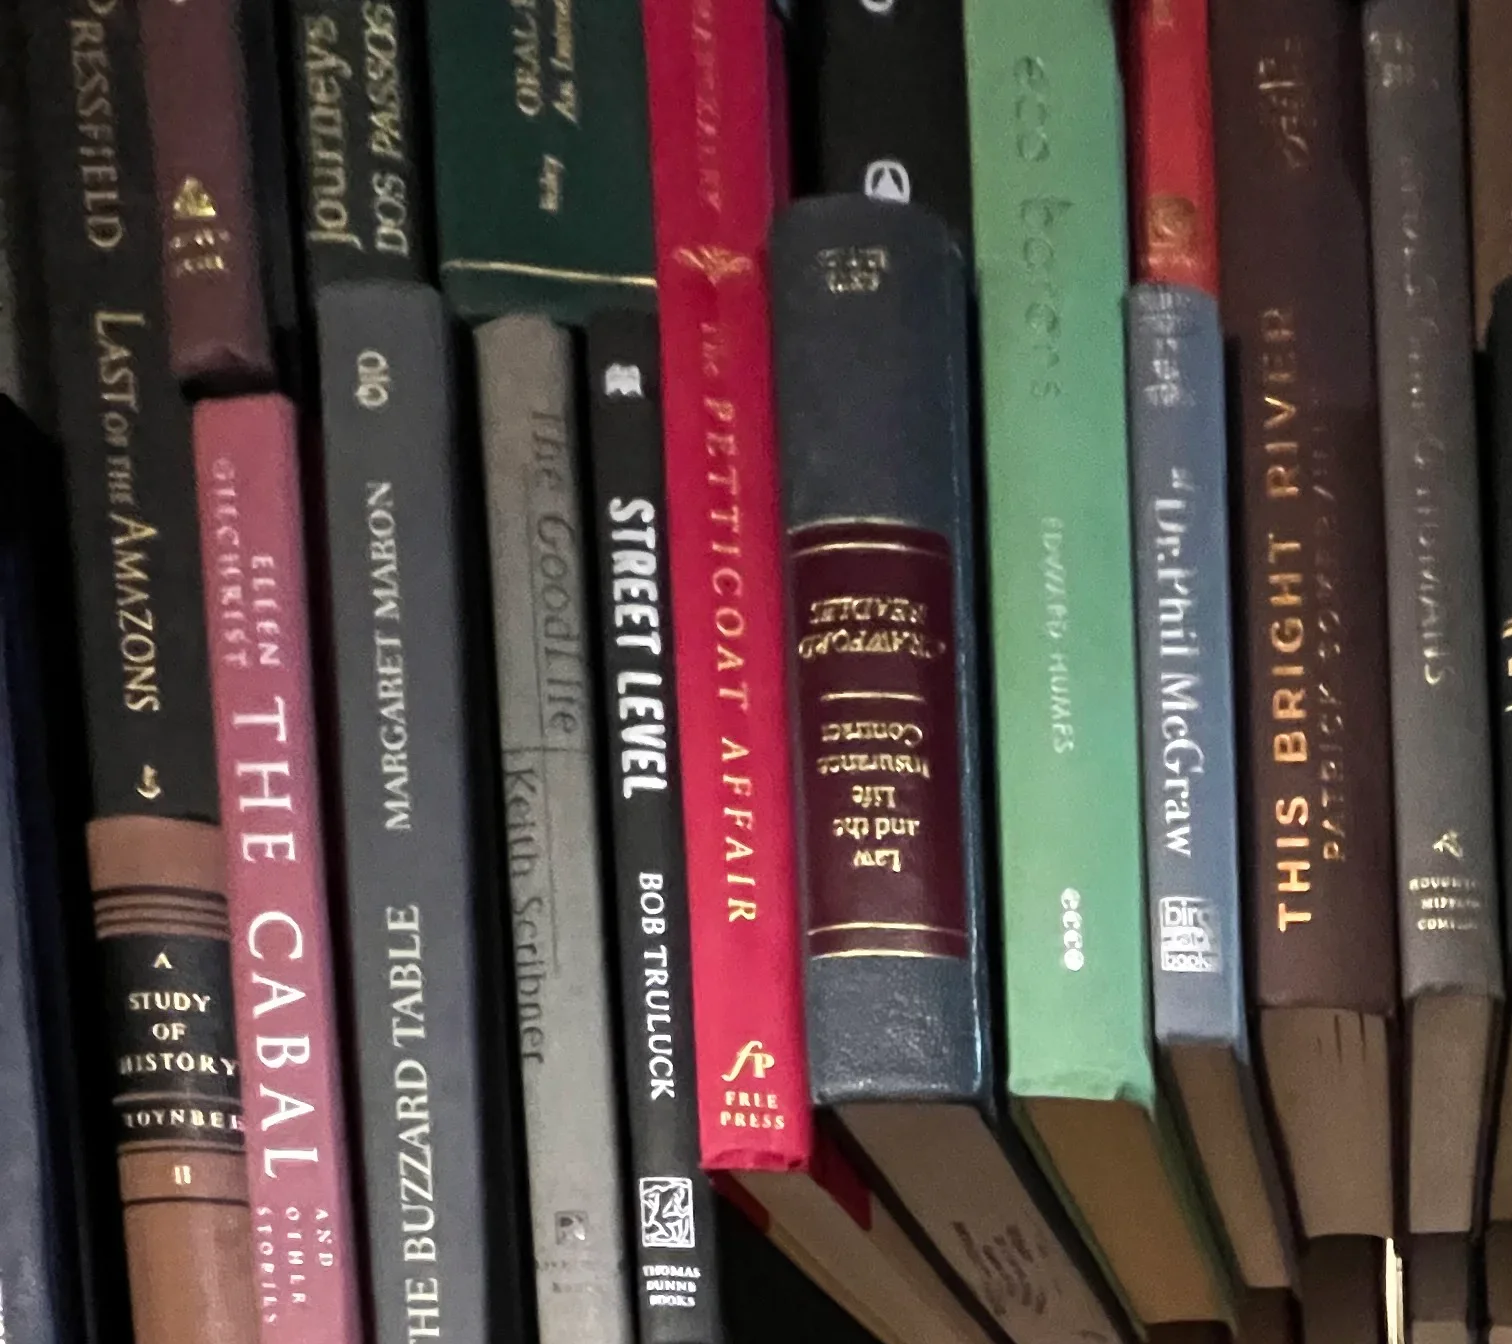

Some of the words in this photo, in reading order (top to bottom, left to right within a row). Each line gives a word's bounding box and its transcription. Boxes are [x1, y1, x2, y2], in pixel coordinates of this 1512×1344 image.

[303, 15, 363, 252] Journeys
[375, 173, 410, 258] DOS
[96, 310, 144, 408] LAST
[1263, 307, 1300, 499] RIVER
[110, 513, 162, 713] AMAZONS
[364, 480, 402, 616] MARON
[610, 497, 660, 657] STREET
[702, 397, 750, 716] PETTICOAT
[1266, 531, 1310, 761] BRIGHT
[231, 697, 296, 864] THE
[371, 629, 410, 832] MARGARET
[616, 671, 668, 799] LEVEL
[852, 785, 896, 808] Life
[1160, 668, 1204, 857] McGraw
[504, 767, 535, 882] Keith
[721, 736, 757, 925] AFFAIR
[853, 850, 901, 872] Law
[1275, 794, 1311, 932] THIS
[153, 951, 170, 970] A
[639, 872, 663, 935] BOB
[128, 991, 211, 1013] STUDY
[153, 1022, 186, 1041] OF
[385, 904, 420, 1041] TABLE
[512, 893, 545, 1066] Scribner
[643, 945, 676, 1100] TRULUCK
[118, 1053, 240, 1077] HISTORY
[247, 909, 319, 1181] CABAL
[392, 1058, 437, 1267] BUZZARD
[719, 1109, 786, 1131] PRESS
[284, 1205, 308, 1307] OTHER
[314, 1207, 335, 1268] AND
[642, 1264, 701, 1278] THOMAS
